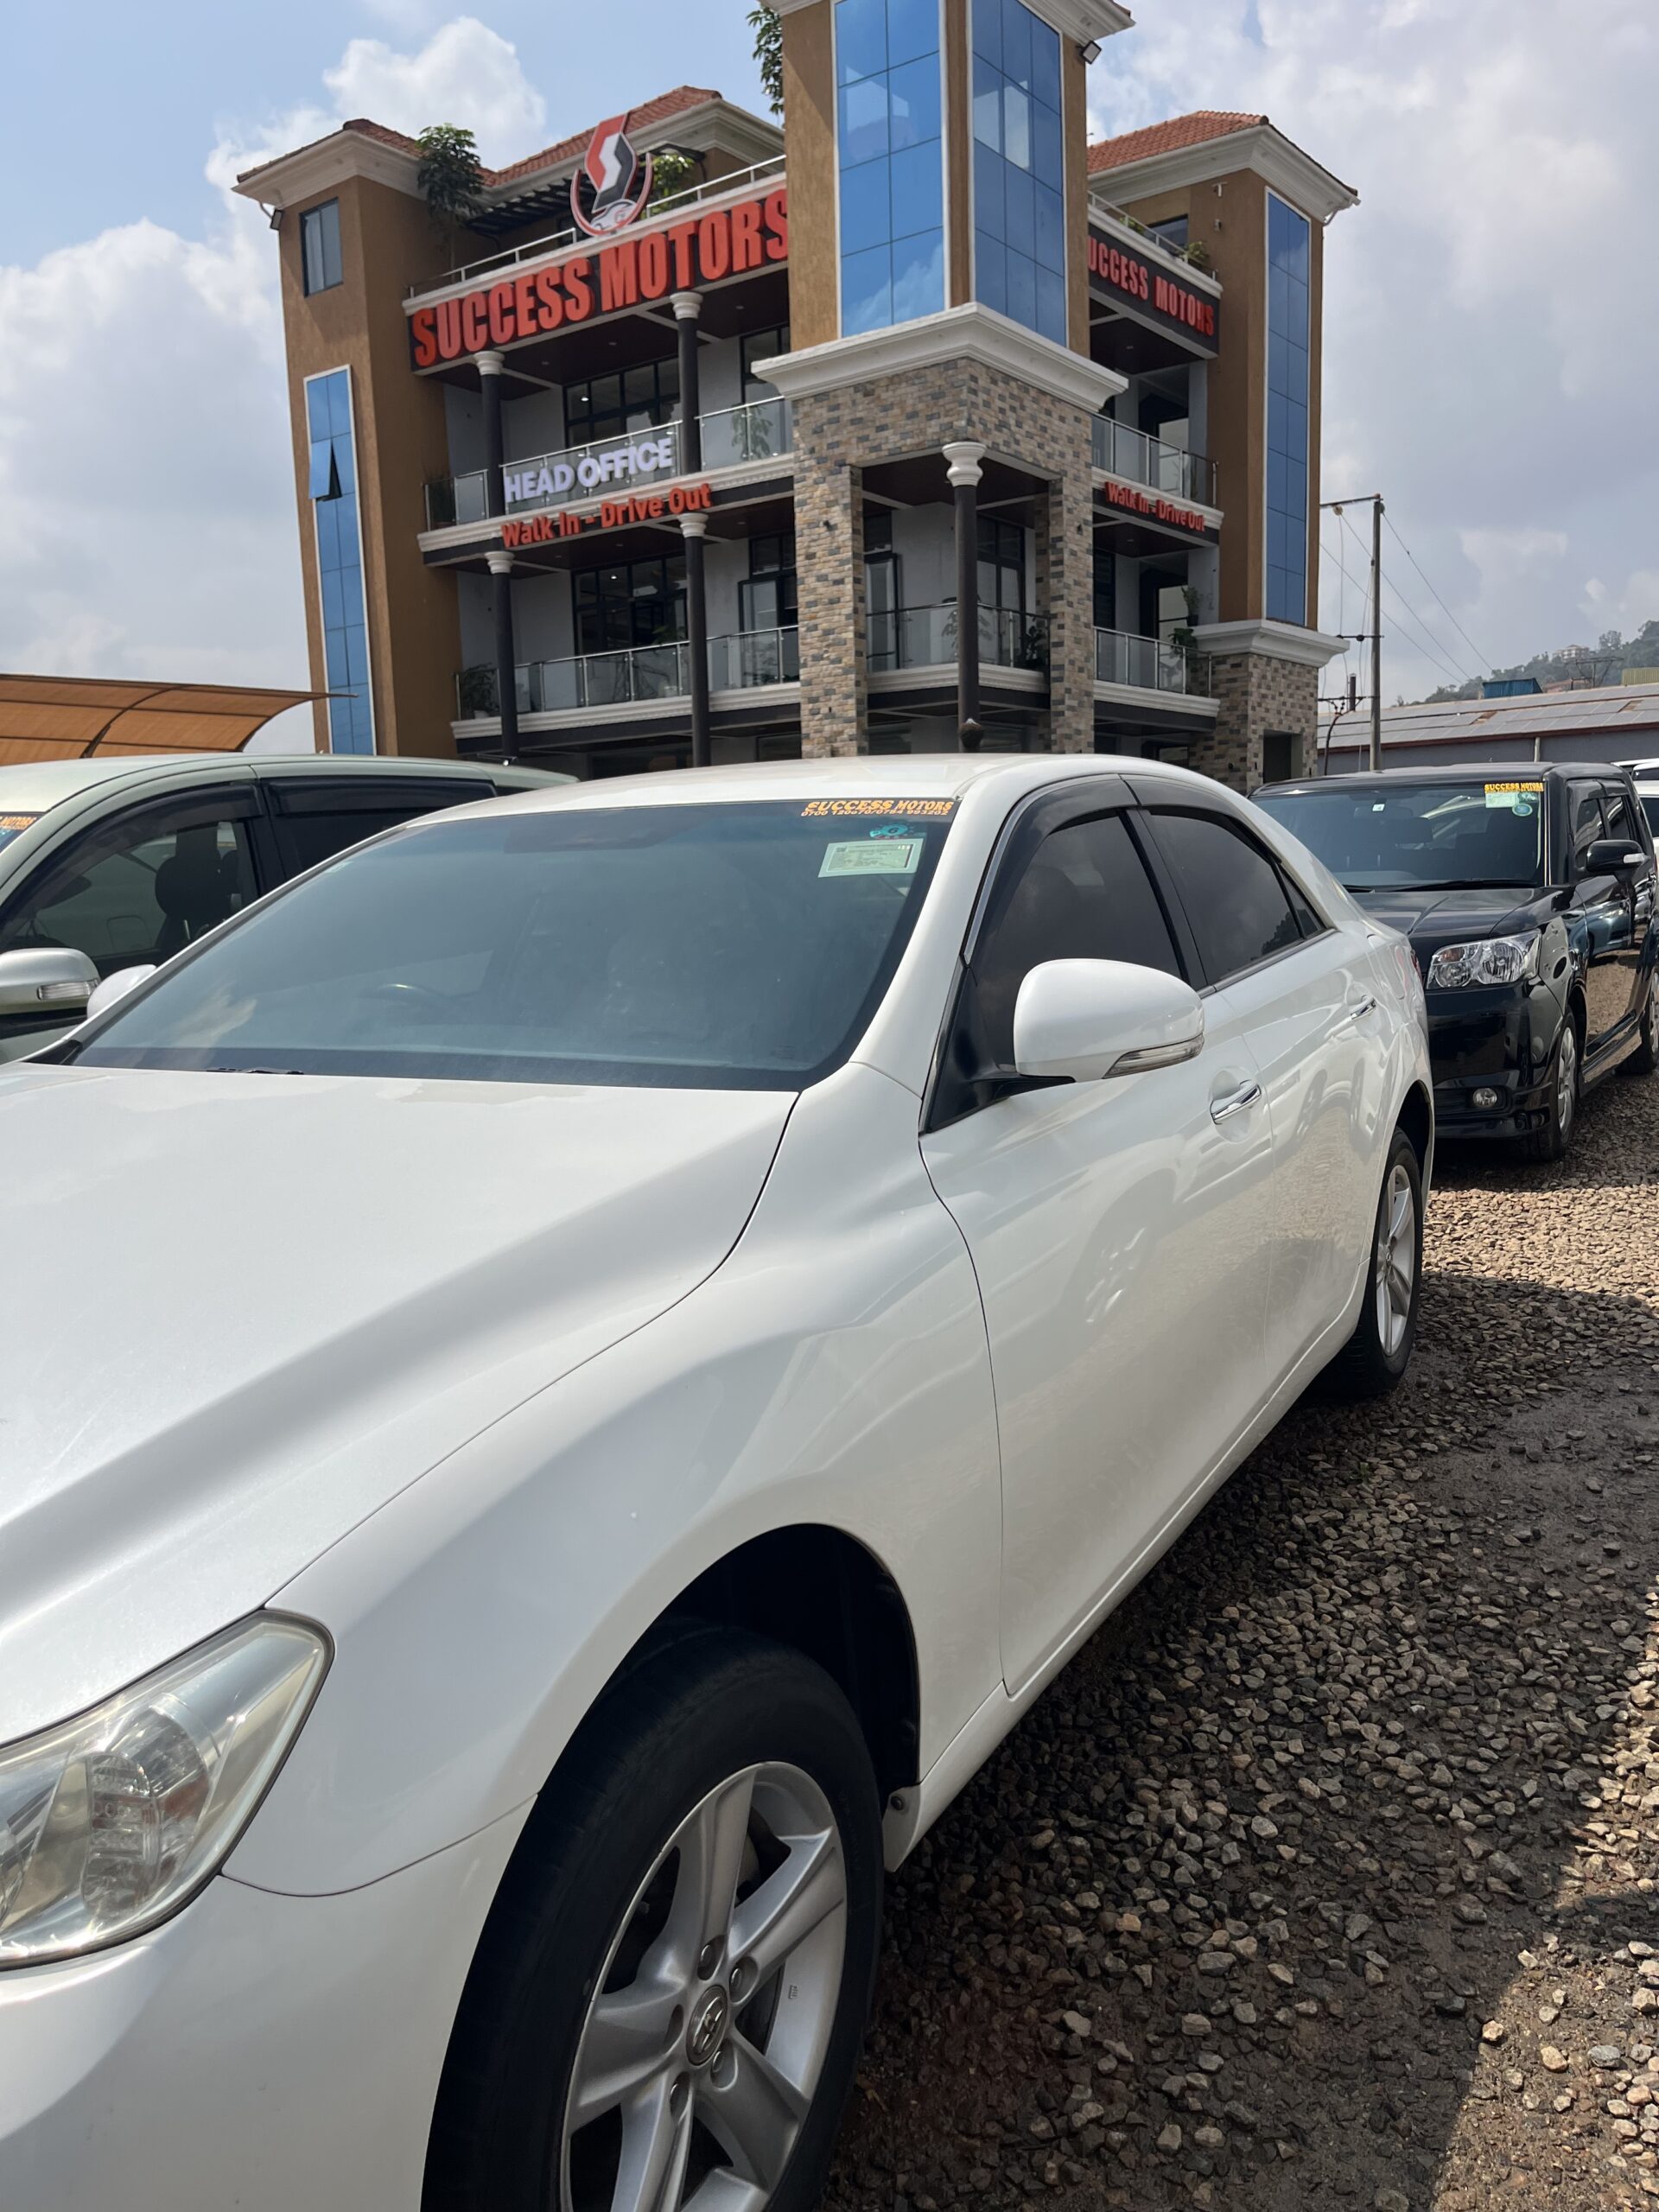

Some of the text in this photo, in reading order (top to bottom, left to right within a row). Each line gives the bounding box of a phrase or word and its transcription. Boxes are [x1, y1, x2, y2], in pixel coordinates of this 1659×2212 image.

[412, 188, 788, 367] SUCCESS MOTORS
[1087, 234, 1215, 336] UCCESS MOTORS
[504, 437, 674, 503] HEAD OFFICE
[501, 513, 554, 549] Walk
[559, 512, 582, 537] In
[601, 497, 664, 529] Drive
[668, 483, 712, 515] Out
[1105, 481, 1137, 509] Walk
[1156, 499, 1186, 525] Drive
[1187, 511, 1205, 531] Out
[805, 800, 955, 811] SUCCESS MOTORS
